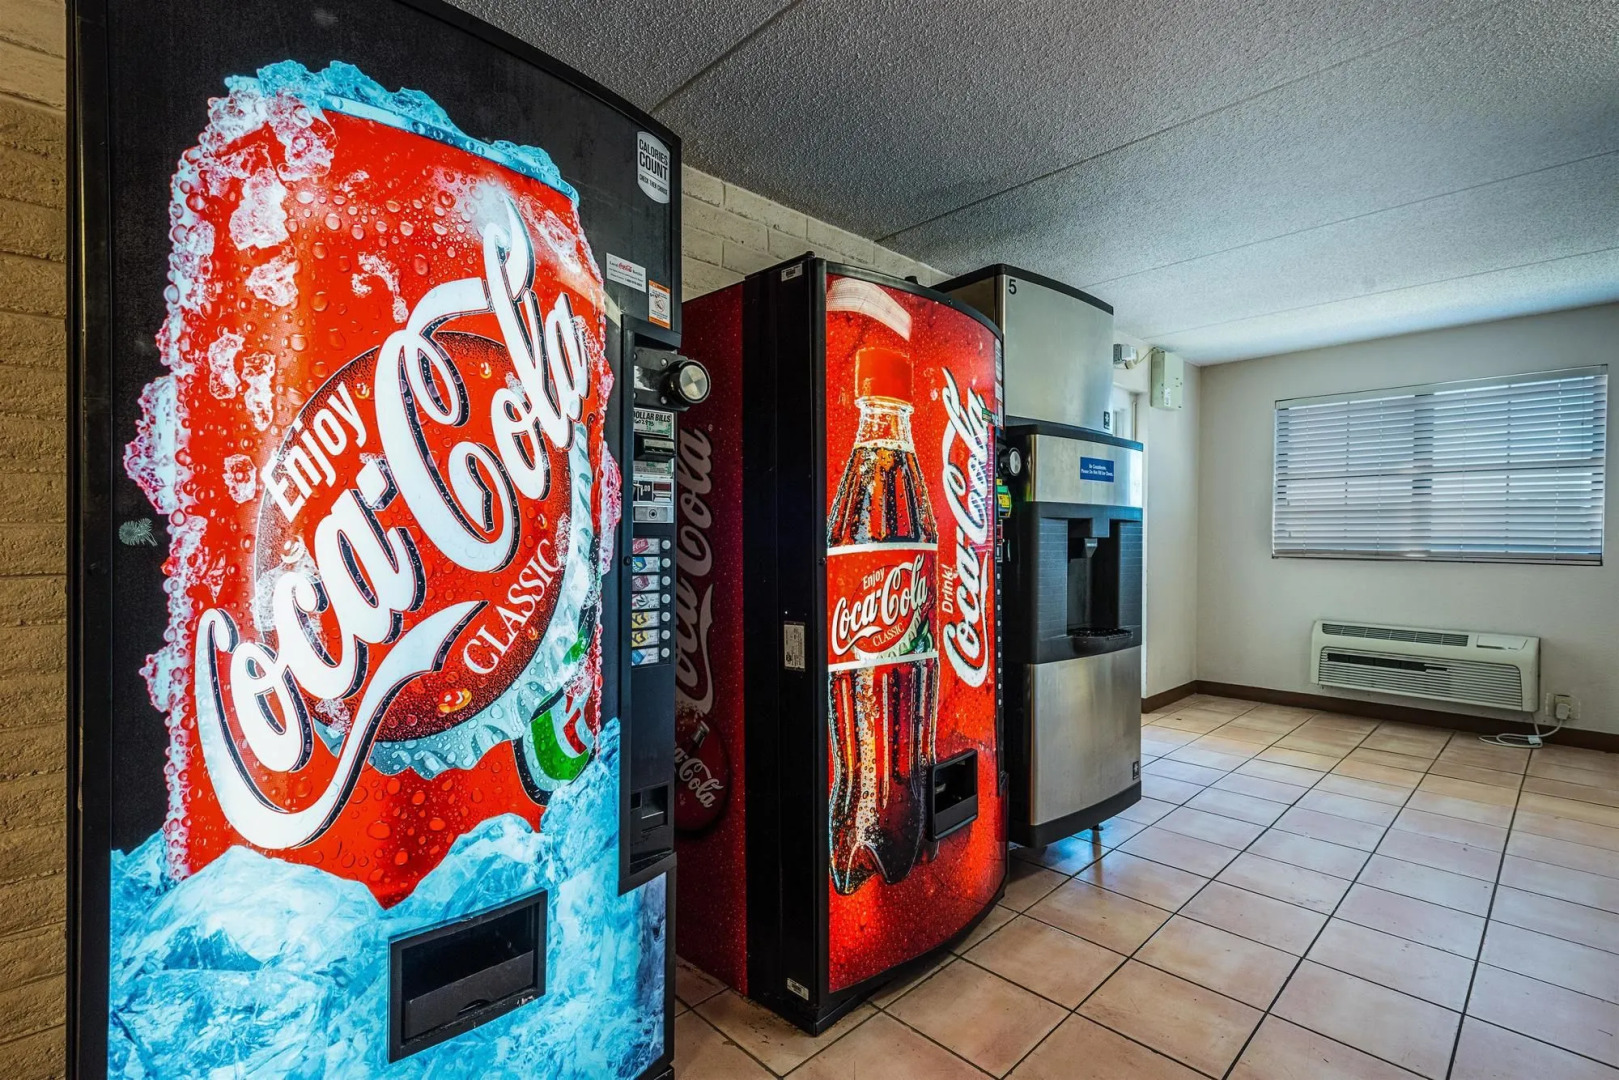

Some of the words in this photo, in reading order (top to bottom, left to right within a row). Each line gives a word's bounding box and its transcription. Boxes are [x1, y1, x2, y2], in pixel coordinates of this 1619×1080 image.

[639, 139, 668, 166] CALORIES
[640, 151, 668, 181] COUNT
[1008, 278, 1017, 295] 5
[655, 412, 671, 423] BILLS
[260, 379, 369, 521] Enjoy
[196, 191, 590, 850] Coca-Cola
[941, 366, 989, 688] Coca-Cola
[675, 428, 714, 716] CocaCola
[863, 567, 885, 590] Enjoy
[941, 564, 953, 615] Drink!
[462, 537, 566, 678] CLASSIC
[831, 552, 928, 656] Coca-Cola
[872, 622, 905, 647] CLASSIC
[674, 742, 724, 809] a-Cola
